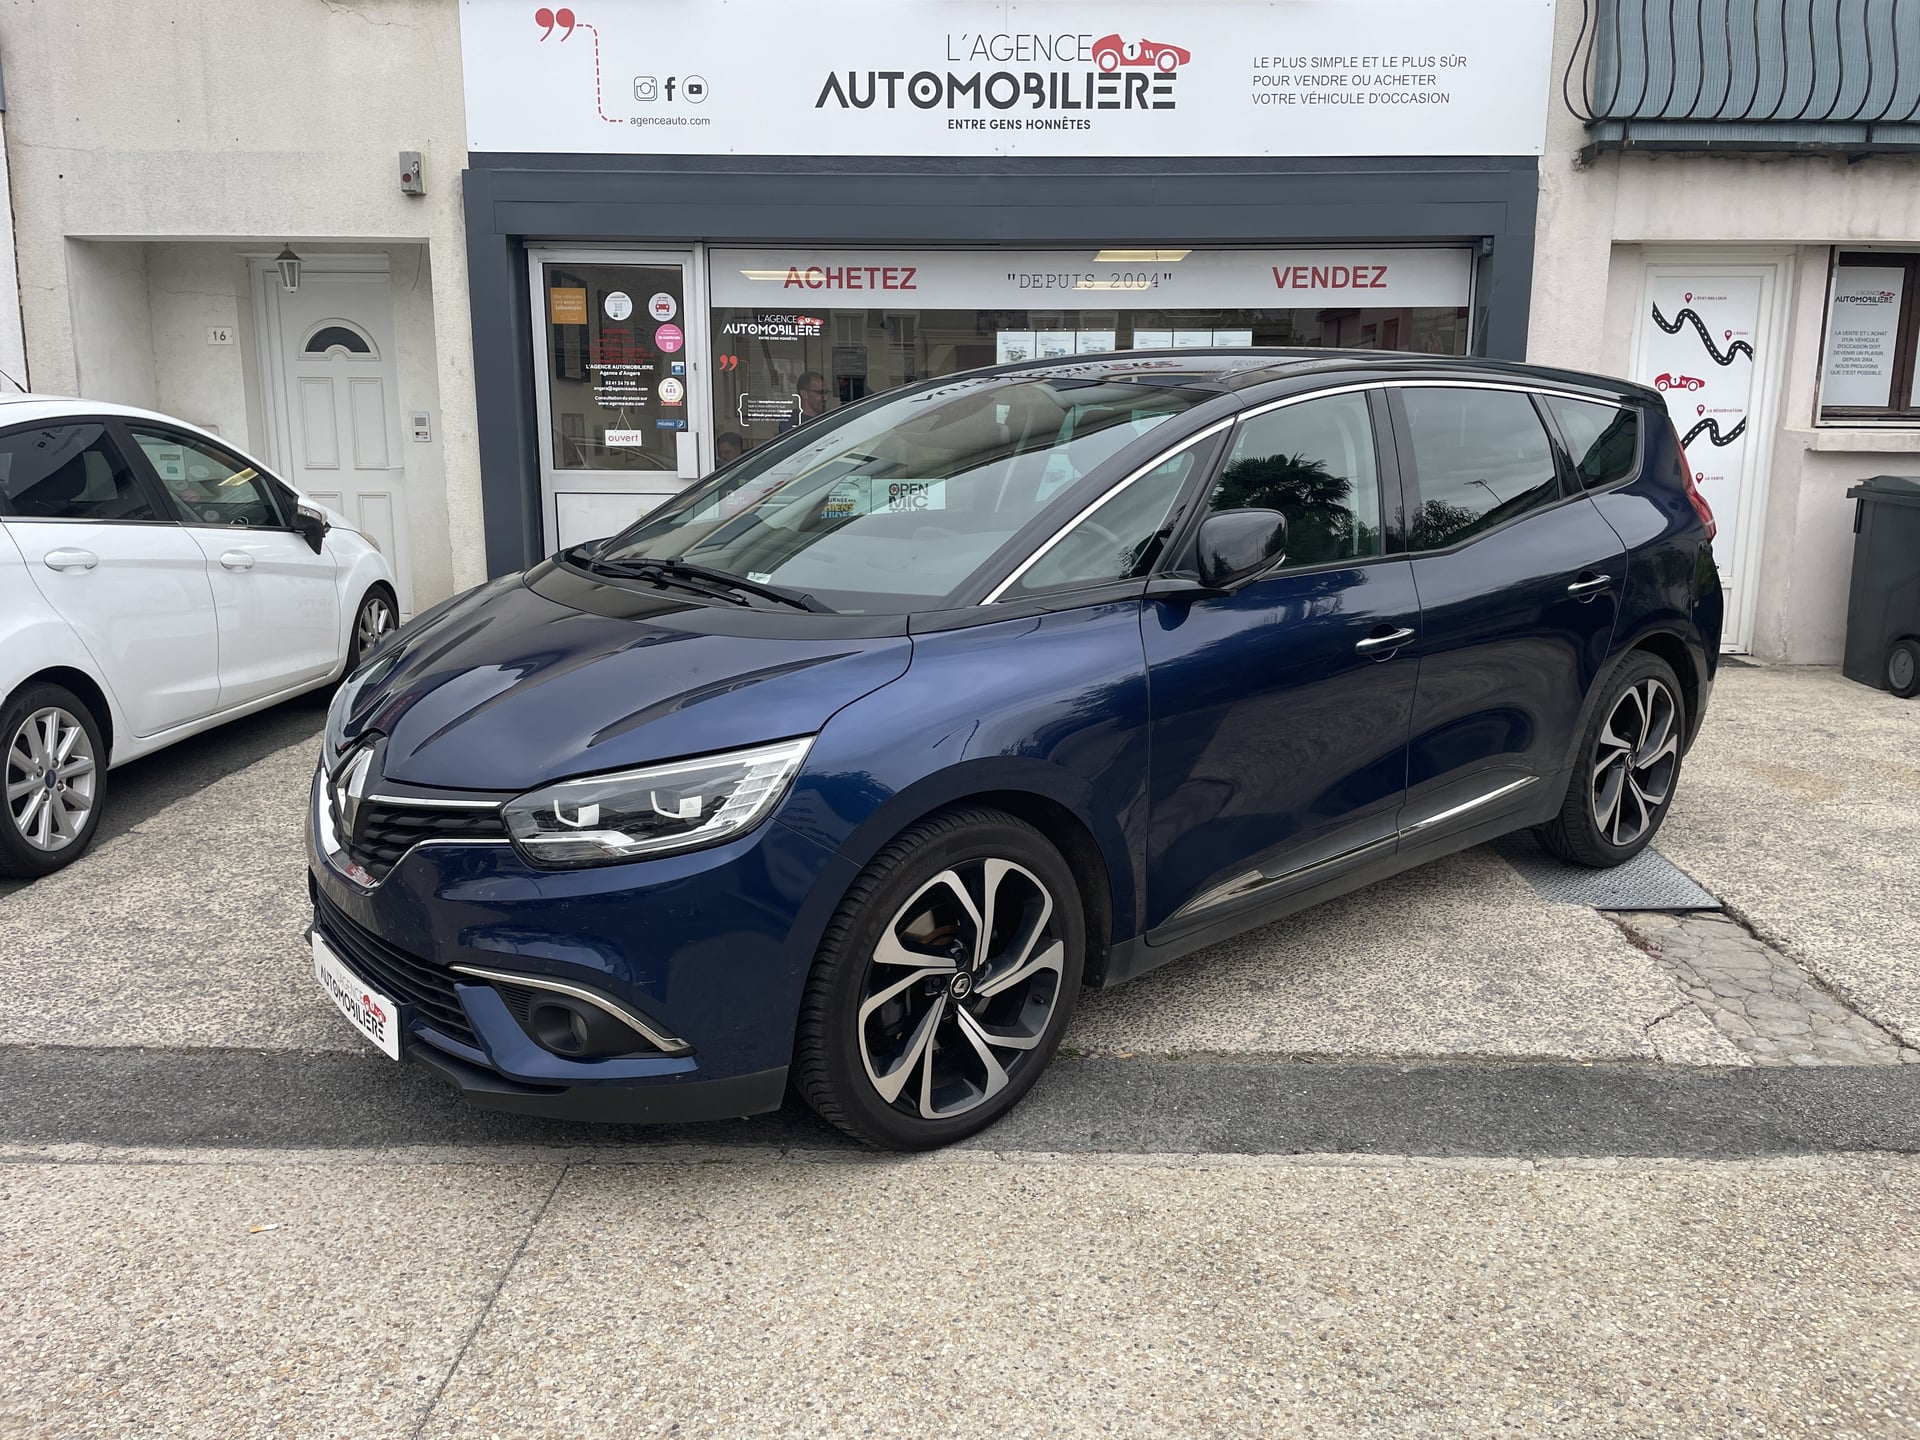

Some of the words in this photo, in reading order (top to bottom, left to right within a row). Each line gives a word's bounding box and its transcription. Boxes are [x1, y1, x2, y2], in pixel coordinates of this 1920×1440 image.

[947, 34, 1093, 62] L'AGENCE
[1253, 57, 1269, 68] LE
[1273, 56, 1307, 68] PLUS
[1310, 56, 1358, 68] SIMPLE
[1362, 56, 1379, 68] ET
[1382, 56, 1398, 68] LE
[1402, 56, 1436, 68] PLUS
[1439, 54, 1467, 68] SÛR
[1252, 75, 1290, 86] POUR
[1294, 75, 1348, 86] VENDRE
[1351, 75, 1371, 86] OU
[1373, 75, 1436, 86] ACHETER
[1252, 93, 1296, 105] VOTRE
[1300, 91, 1365, 105] VÉHICULE
[1368, 92, 1450, 104] D'OCCASION
[630, 115, 711, 127] agenceauto.com
[948, 119, 986, 129] ENTRE
[990, 119, 1022, 129] GENS
[1026, 116, 1091, 130] HONNÊTES
[784, 266, 918, 290] ACHETEZ
[1272, 265, 1388, 290] VENDEZ
[757, 314, 798, 323] L'AGENCE
[213, 331, 226, 341] 16
[607, 434, 638, 442] ouvert
[888, 483, 929, 496] OPEN
[888, 495, 929, 509] MIC
